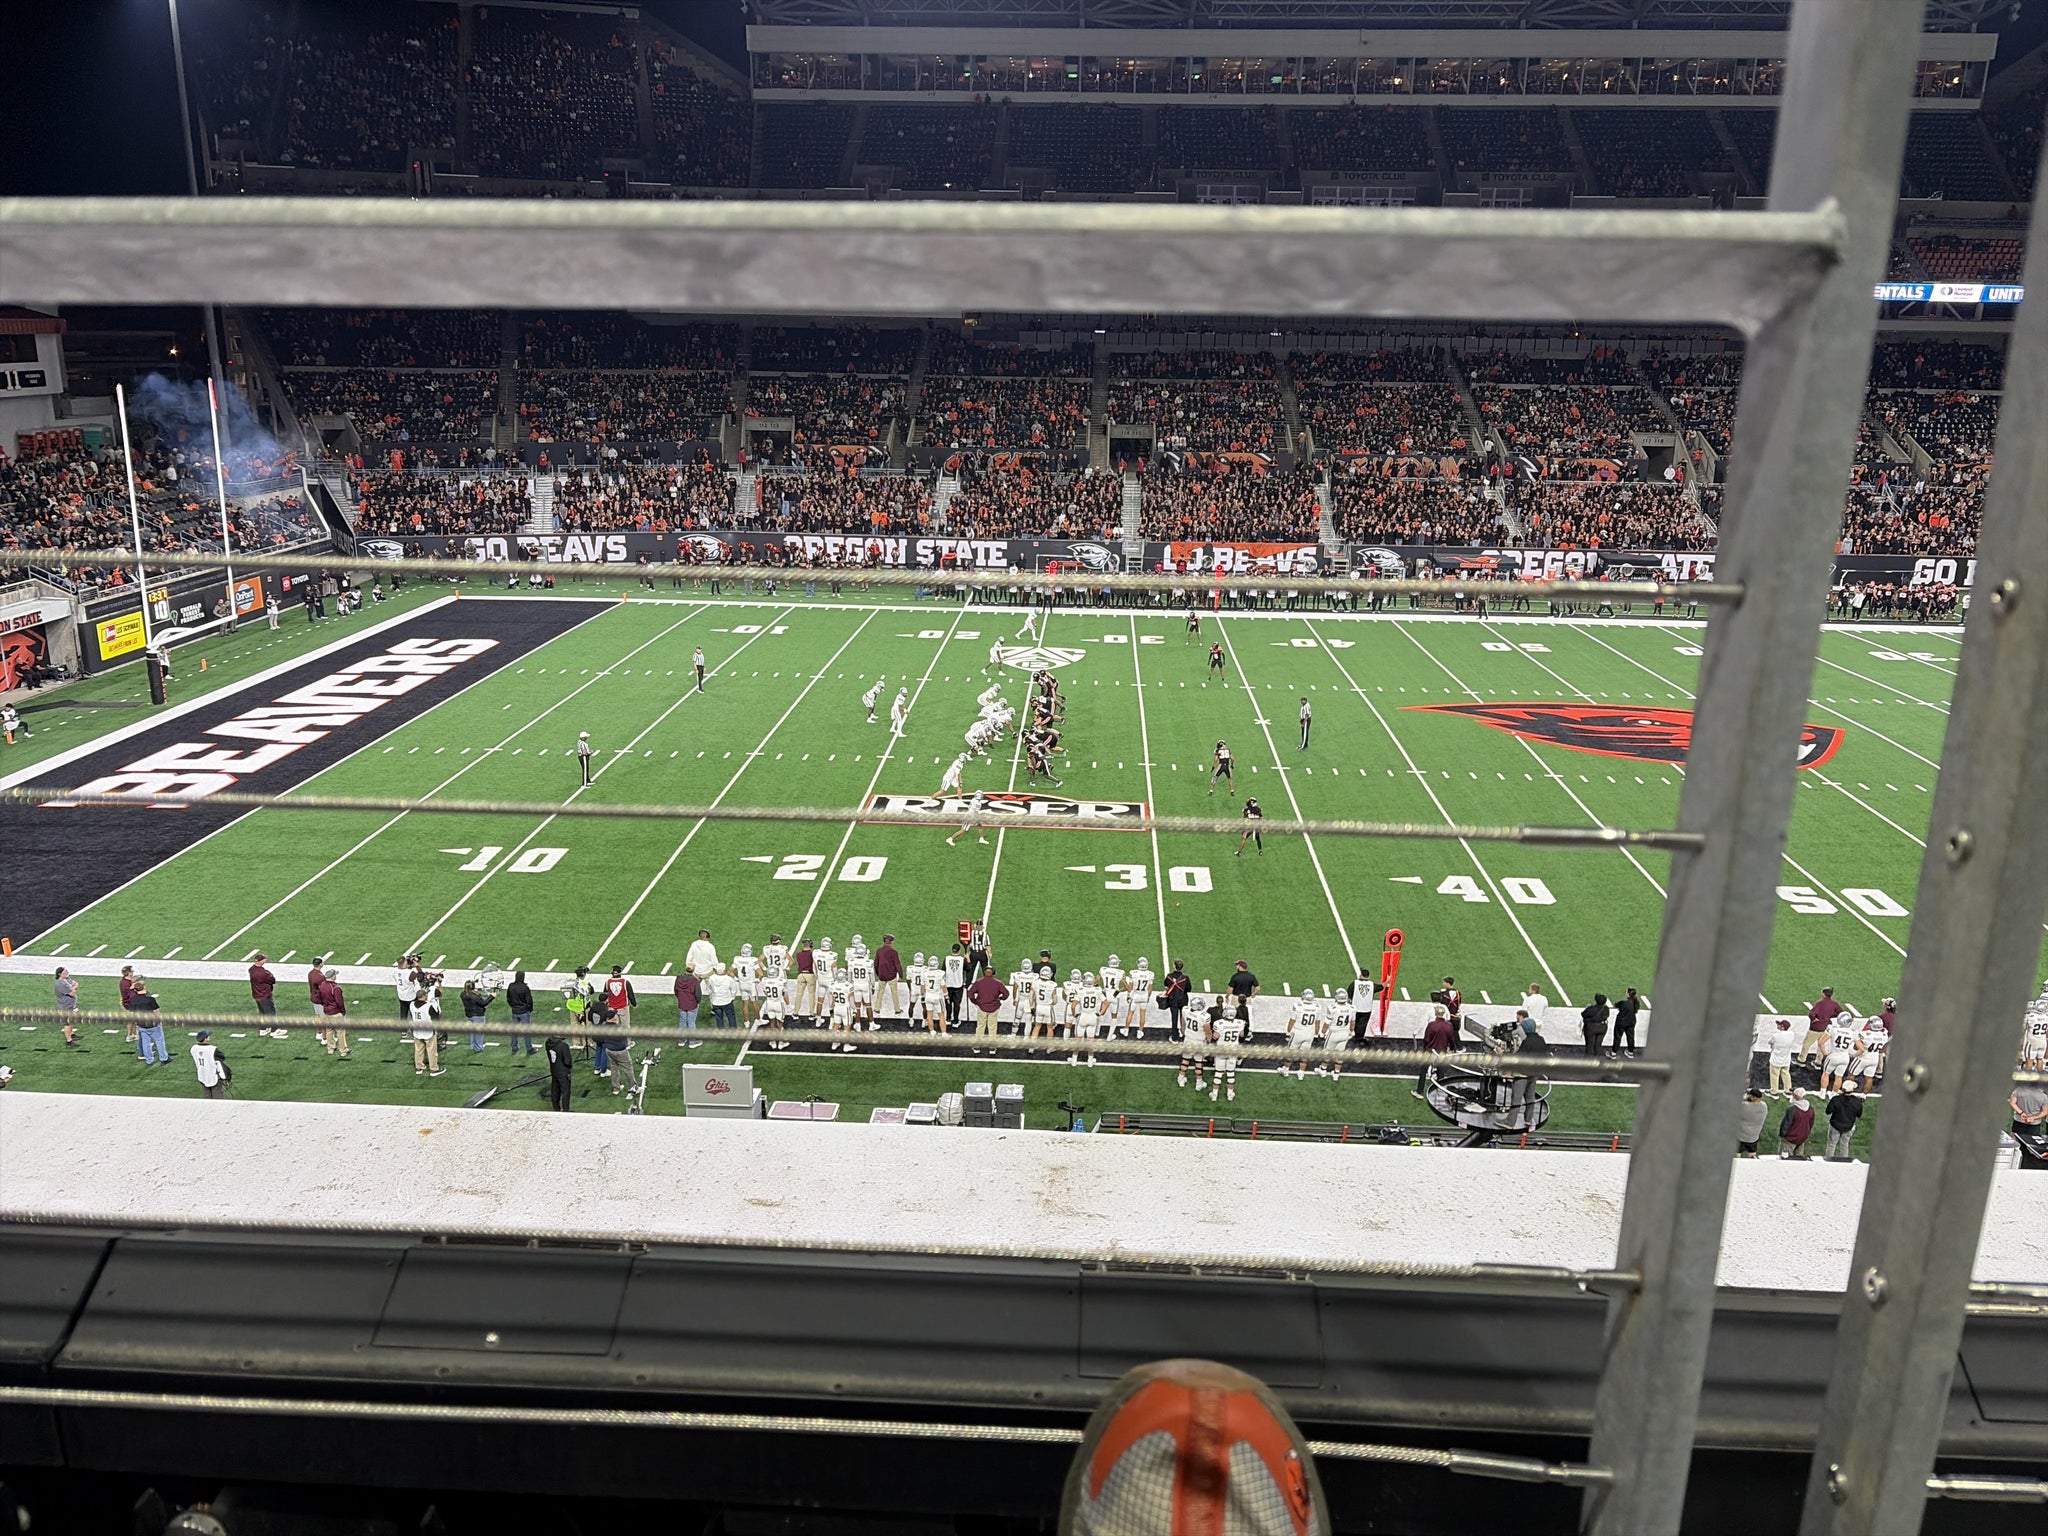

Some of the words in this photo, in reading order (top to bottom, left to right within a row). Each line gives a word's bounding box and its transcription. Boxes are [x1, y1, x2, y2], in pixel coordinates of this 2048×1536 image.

[1344, 172, 1378, 180] TOYOTA
[1494, 173, 1528, 181] TOYOTA
[784, 536, 907, 565] OREGON
[916, 540, 1008, 567] STATE
[1213, 547, 1317, 572] BEVS
[1912, 558, 1958, 585] GO
[291, 574, 309, 584] TOYOTA
[154, 600, 169, 619] 10
[13, 610, 43, 630] STATE
[38, 637, 501, 809] BEAVERS
[883, 797, 1131, 821] RESER
[458, 846, 569, 873] 10
[772, 854, 888, 882] 20
[1103, 863, 1213, 893] 30
[1436, 875, 1557, 905] 40
[1775, 886, 1910, 917] 50
[769, 954, 781, 966] 12
[817, 959, 827, 972] 81
[741, 965, 747, 978] 4
[853, 967, 866, 979] 88
[928, 979, 935, 990] 7
[1020, 981, 1031, 994] 18
[1105, 976, 1116, 989] 14
[1136, 979, 1148, 992] 17
[765, 986, 778, 998] 28
[1039, 989, 1045, 1001] 5
[1083, 996, 1096, 1009] 89
[1186, 1017, 1198, 1032] 78
[1301, 1013, 1315, 1026] 60
[1223, 1031, 1238, 1042] 65
[1835, 1035, 1851, 1050] 45
[704, 1077, 731, 1093] Griz
